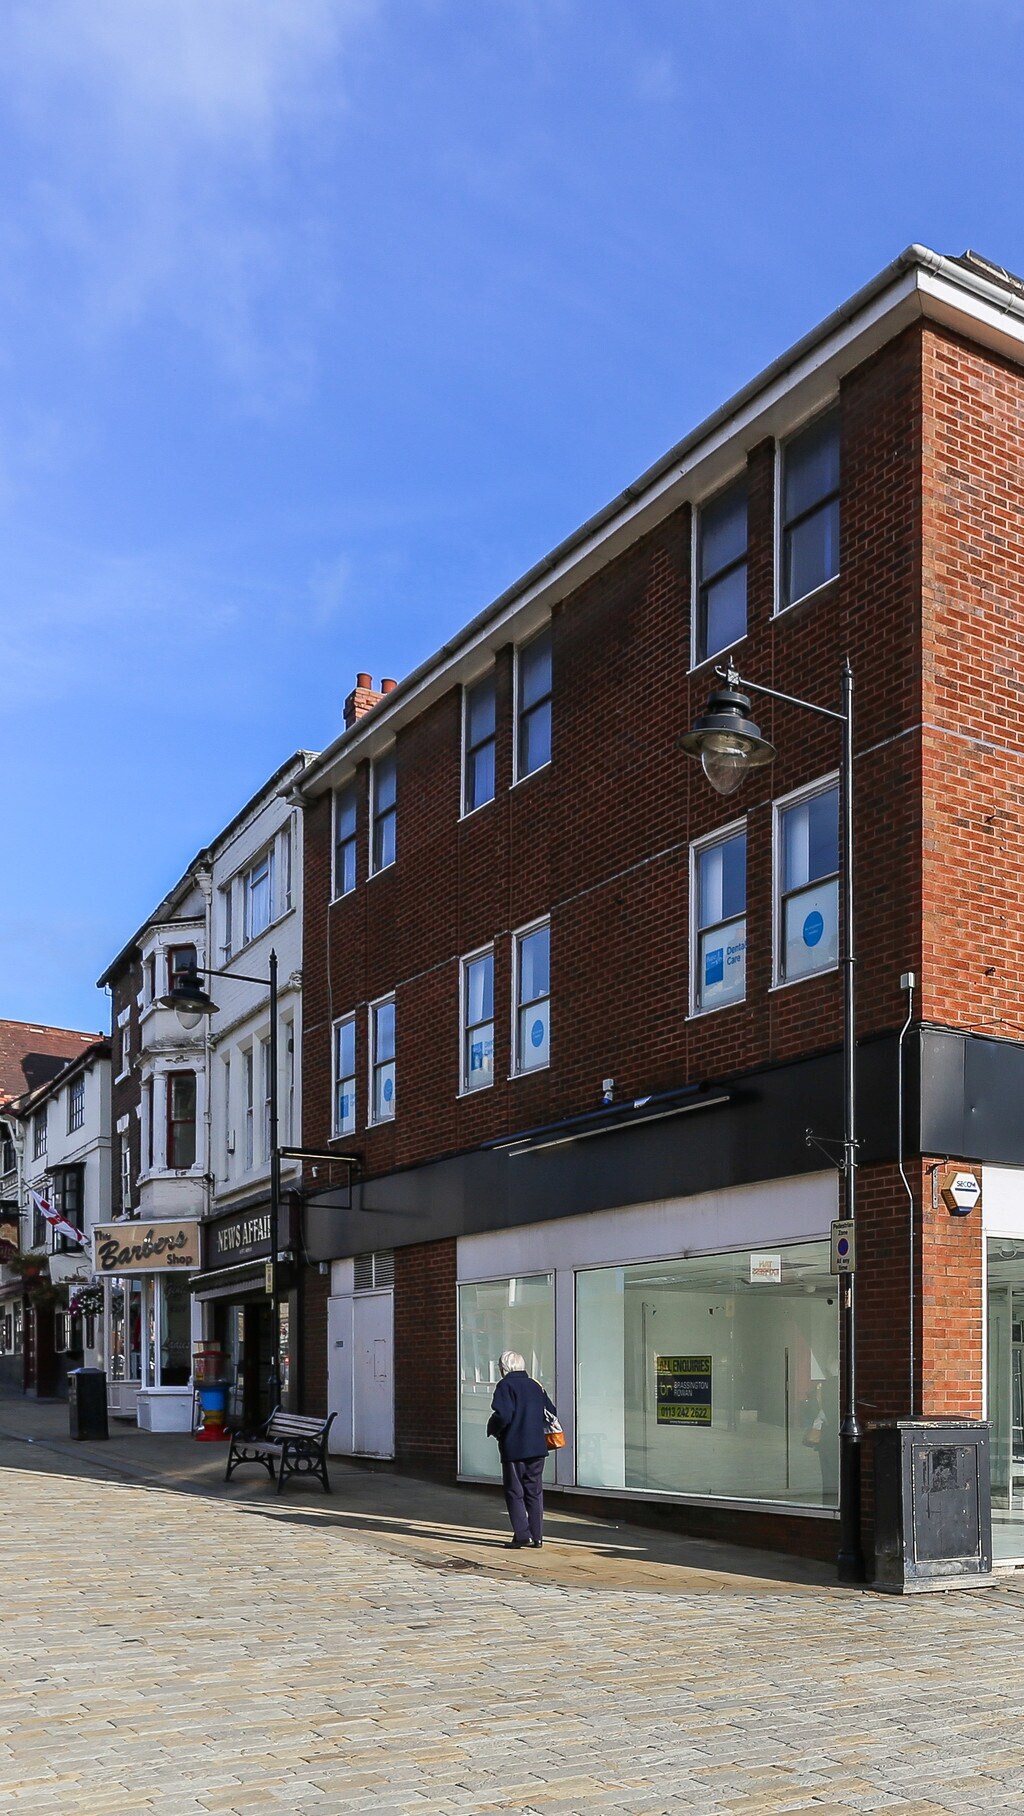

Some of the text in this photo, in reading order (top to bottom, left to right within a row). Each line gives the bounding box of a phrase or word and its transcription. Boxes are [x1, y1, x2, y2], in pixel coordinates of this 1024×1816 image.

[726, 942, 748, 955] Denta
[726, 955, 741, 965] Care
[956, 1180, 976, 1188] SECOM
[833, 1222, 854, 1230] Pedestrian
[94, 1230, 111, 1240] The
[218, 1224, 241, 1252] NEWS
[98, 1228, 188, 1270] Barbers
[166, 1254, 193, 1266] Shop
[658, 1359, 710, 1372] ALL ENQUIRIES
[674, 1381, 709, 1389] BRASSINGTON
[674, 1389, 693, 1397] ROWAN
[661, 1407, 708, 1418] 0113 242 2622
